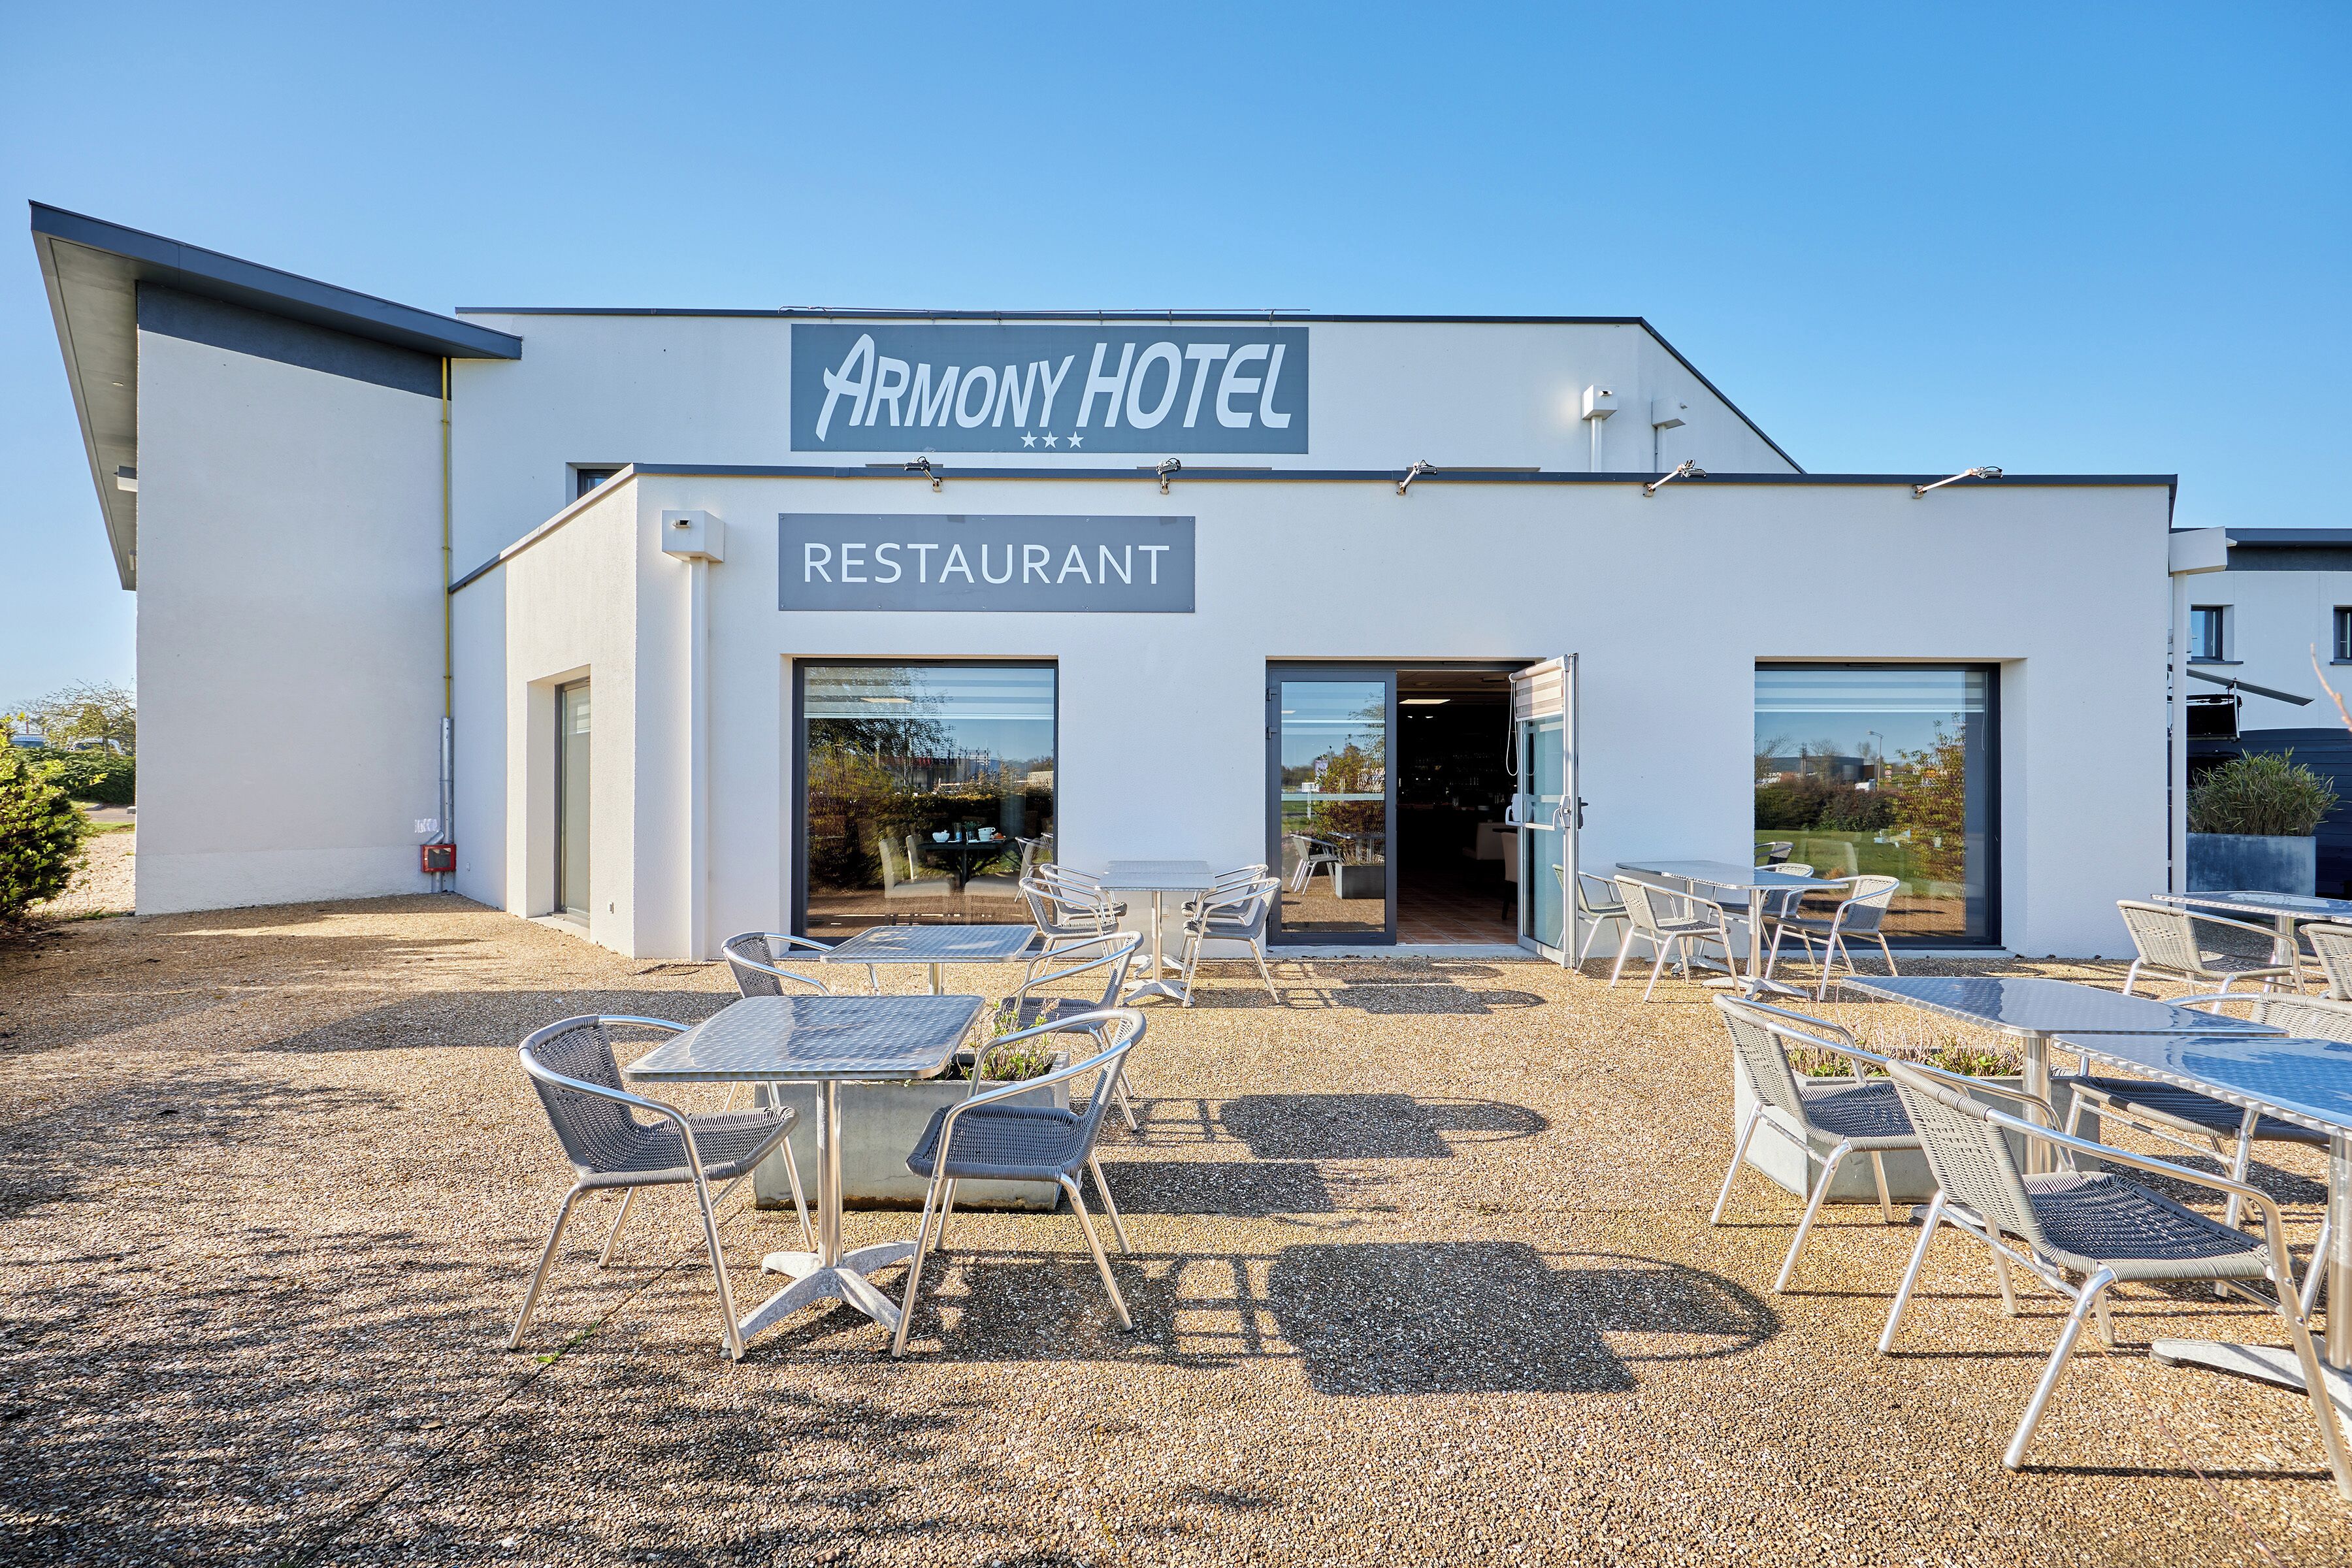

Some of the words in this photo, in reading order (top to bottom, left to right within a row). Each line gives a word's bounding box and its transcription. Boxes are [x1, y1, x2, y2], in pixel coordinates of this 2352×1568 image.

[815, 333, 1075, 442] ARMONY
[1077, 342, 1291, 429] HOTEL
[804, 542, 1170, 585] RESTAURANT
